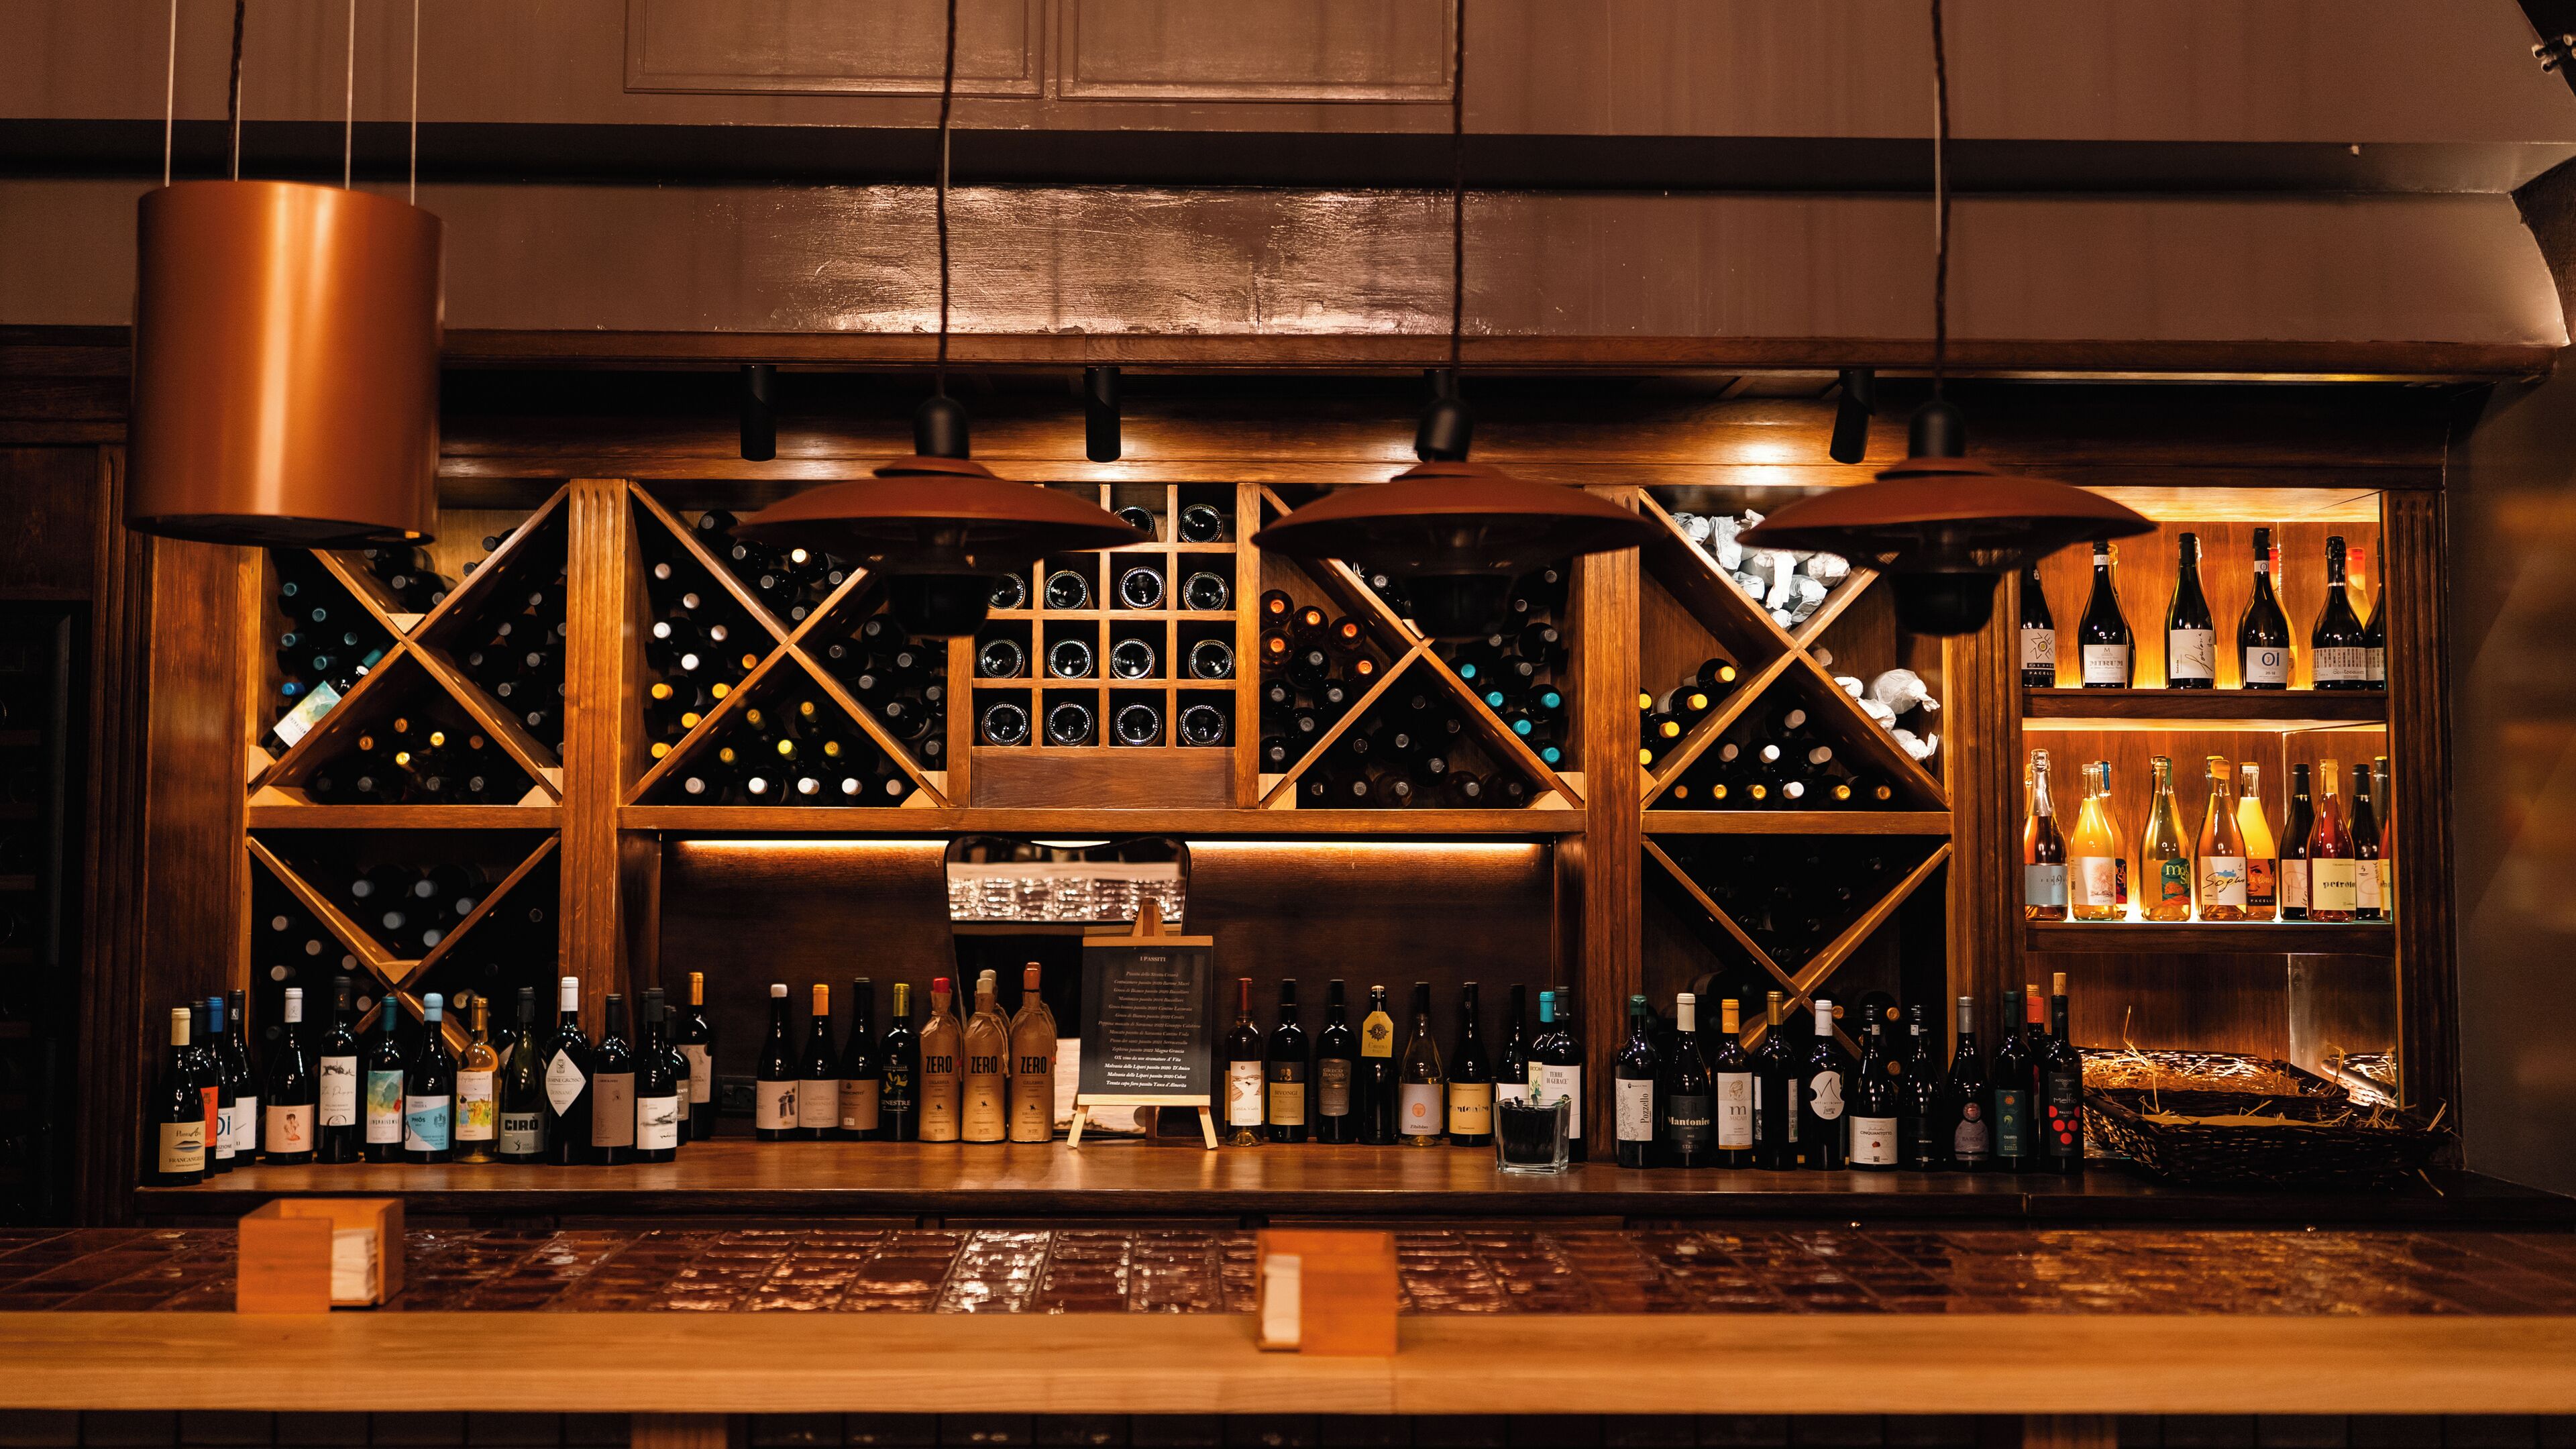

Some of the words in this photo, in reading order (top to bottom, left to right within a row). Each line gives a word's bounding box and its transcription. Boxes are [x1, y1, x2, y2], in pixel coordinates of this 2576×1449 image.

[926, 1055, 953, 1074] ZERO
[970, 1055, 998, 1074] ZERO
[1020, 1055, 1048, 1074] ZERO
[1640, 1093, 1650, 1124] Pozzello
[504, 1116, 539, 1131] CIRÒ
[1668, 1116, 1711, 1126] Mantonico
